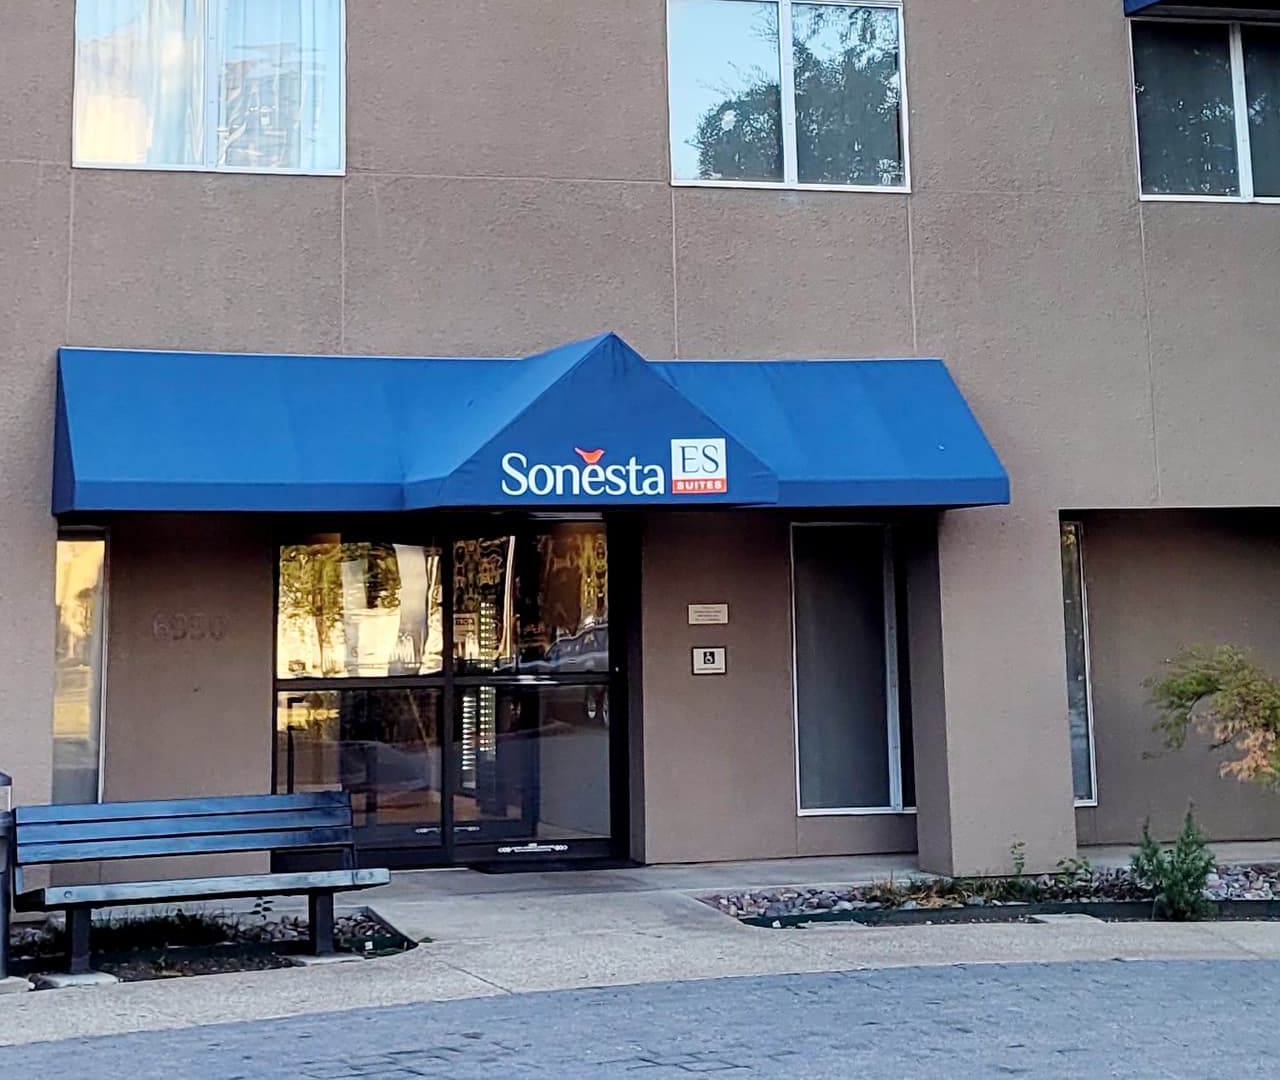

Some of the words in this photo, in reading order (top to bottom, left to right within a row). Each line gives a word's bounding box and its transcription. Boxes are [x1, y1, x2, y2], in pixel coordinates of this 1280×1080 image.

[501, 451, 665, 496] Sonesta
[679, 444, 720, 474] ES
[676, 480, 723, 491] SUITES
